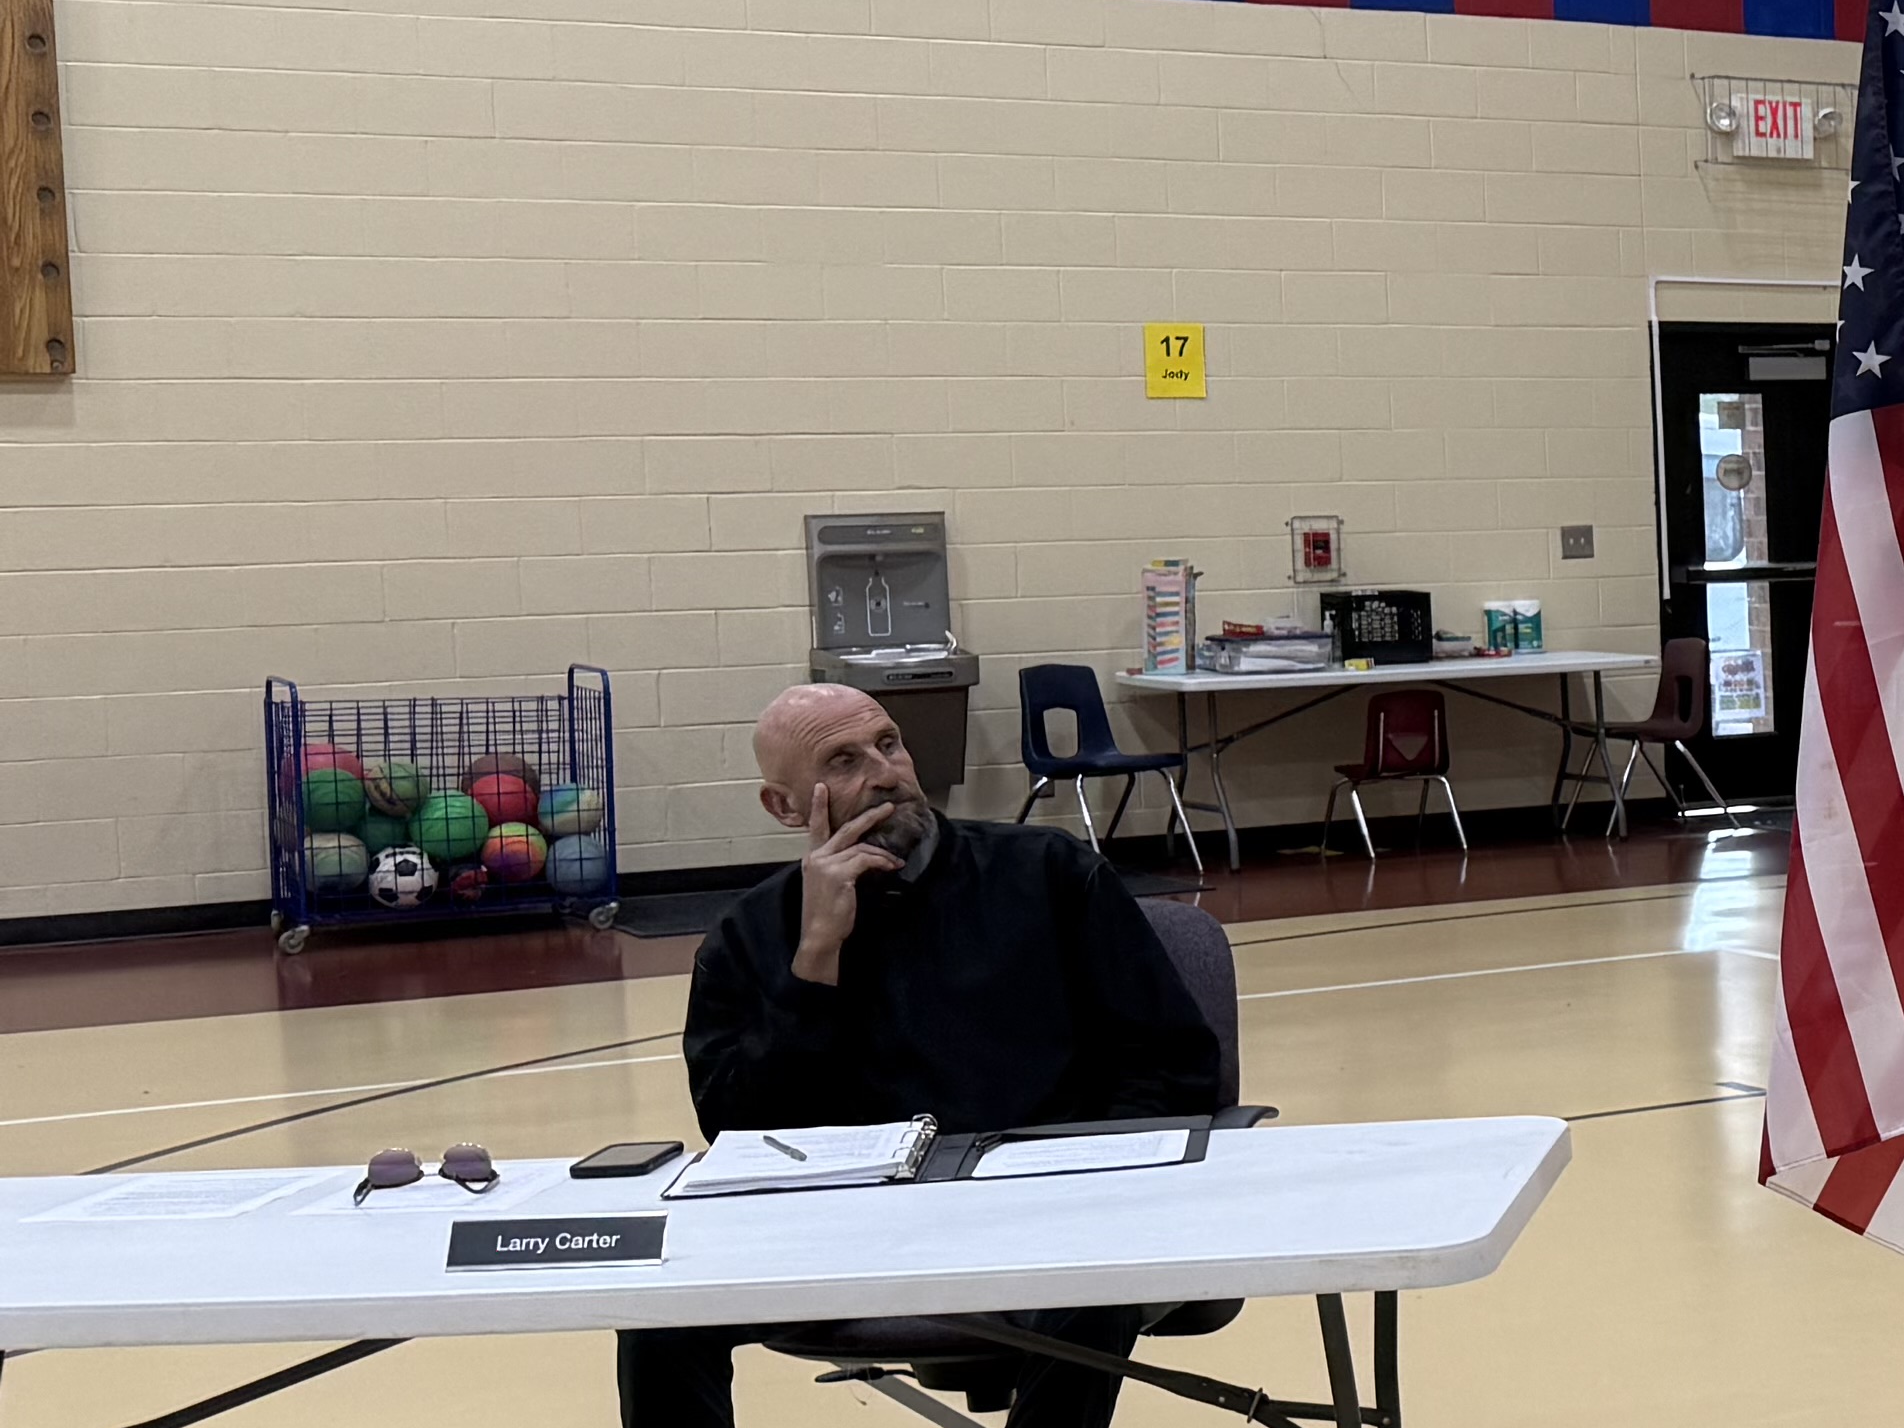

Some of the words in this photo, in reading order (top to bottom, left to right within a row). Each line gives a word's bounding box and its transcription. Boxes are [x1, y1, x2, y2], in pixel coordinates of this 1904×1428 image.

[1753, 99, 1802, 140] EXIT
[1160, 335, 1189, 357] 17
[1161, 369, 1190, 381] Jody
[496, 1234, 549, 1254] Larry
[555, 1232, 621, 1249] Carter
